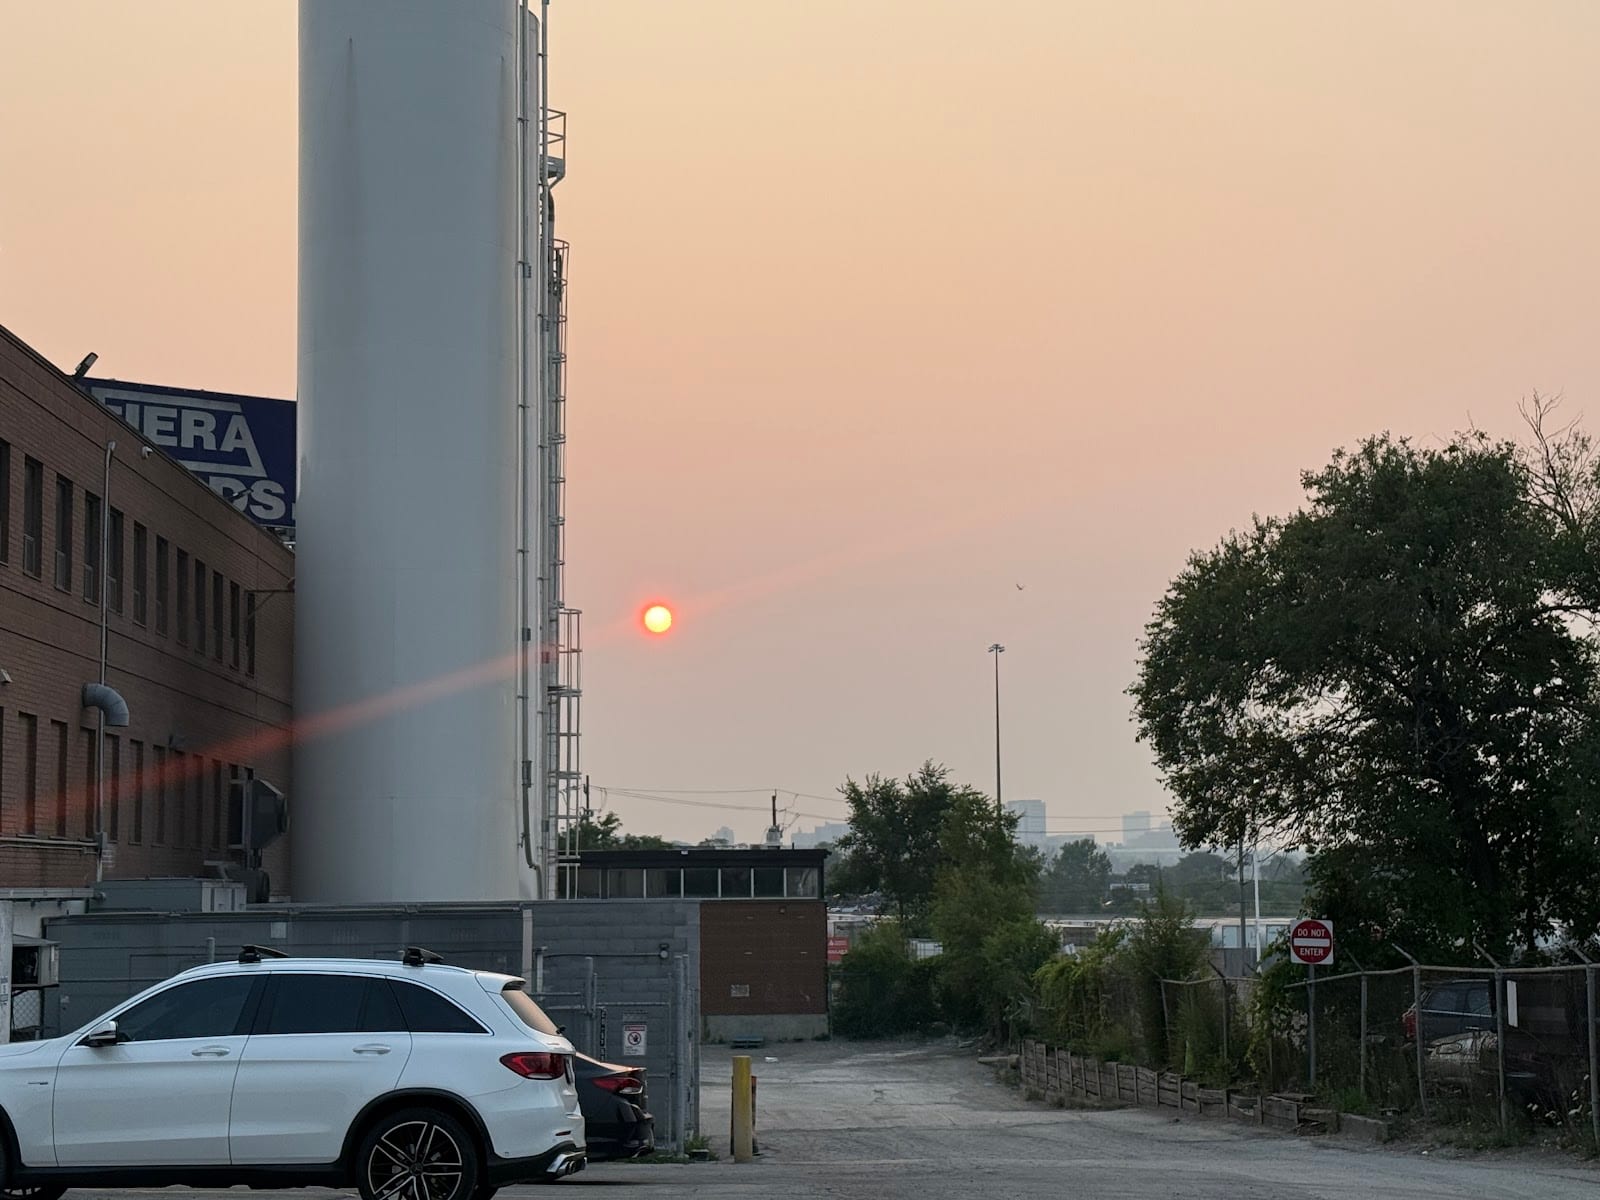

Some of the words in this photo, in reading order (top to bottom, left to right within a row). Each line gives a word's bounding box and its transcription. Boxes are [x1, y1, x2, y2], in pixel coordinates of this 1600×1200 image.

[1297, 928, 1308, 936] DO
[1311, 929, 1326, 937] NOT
[1299, 948, 1324, 956] ENTER
